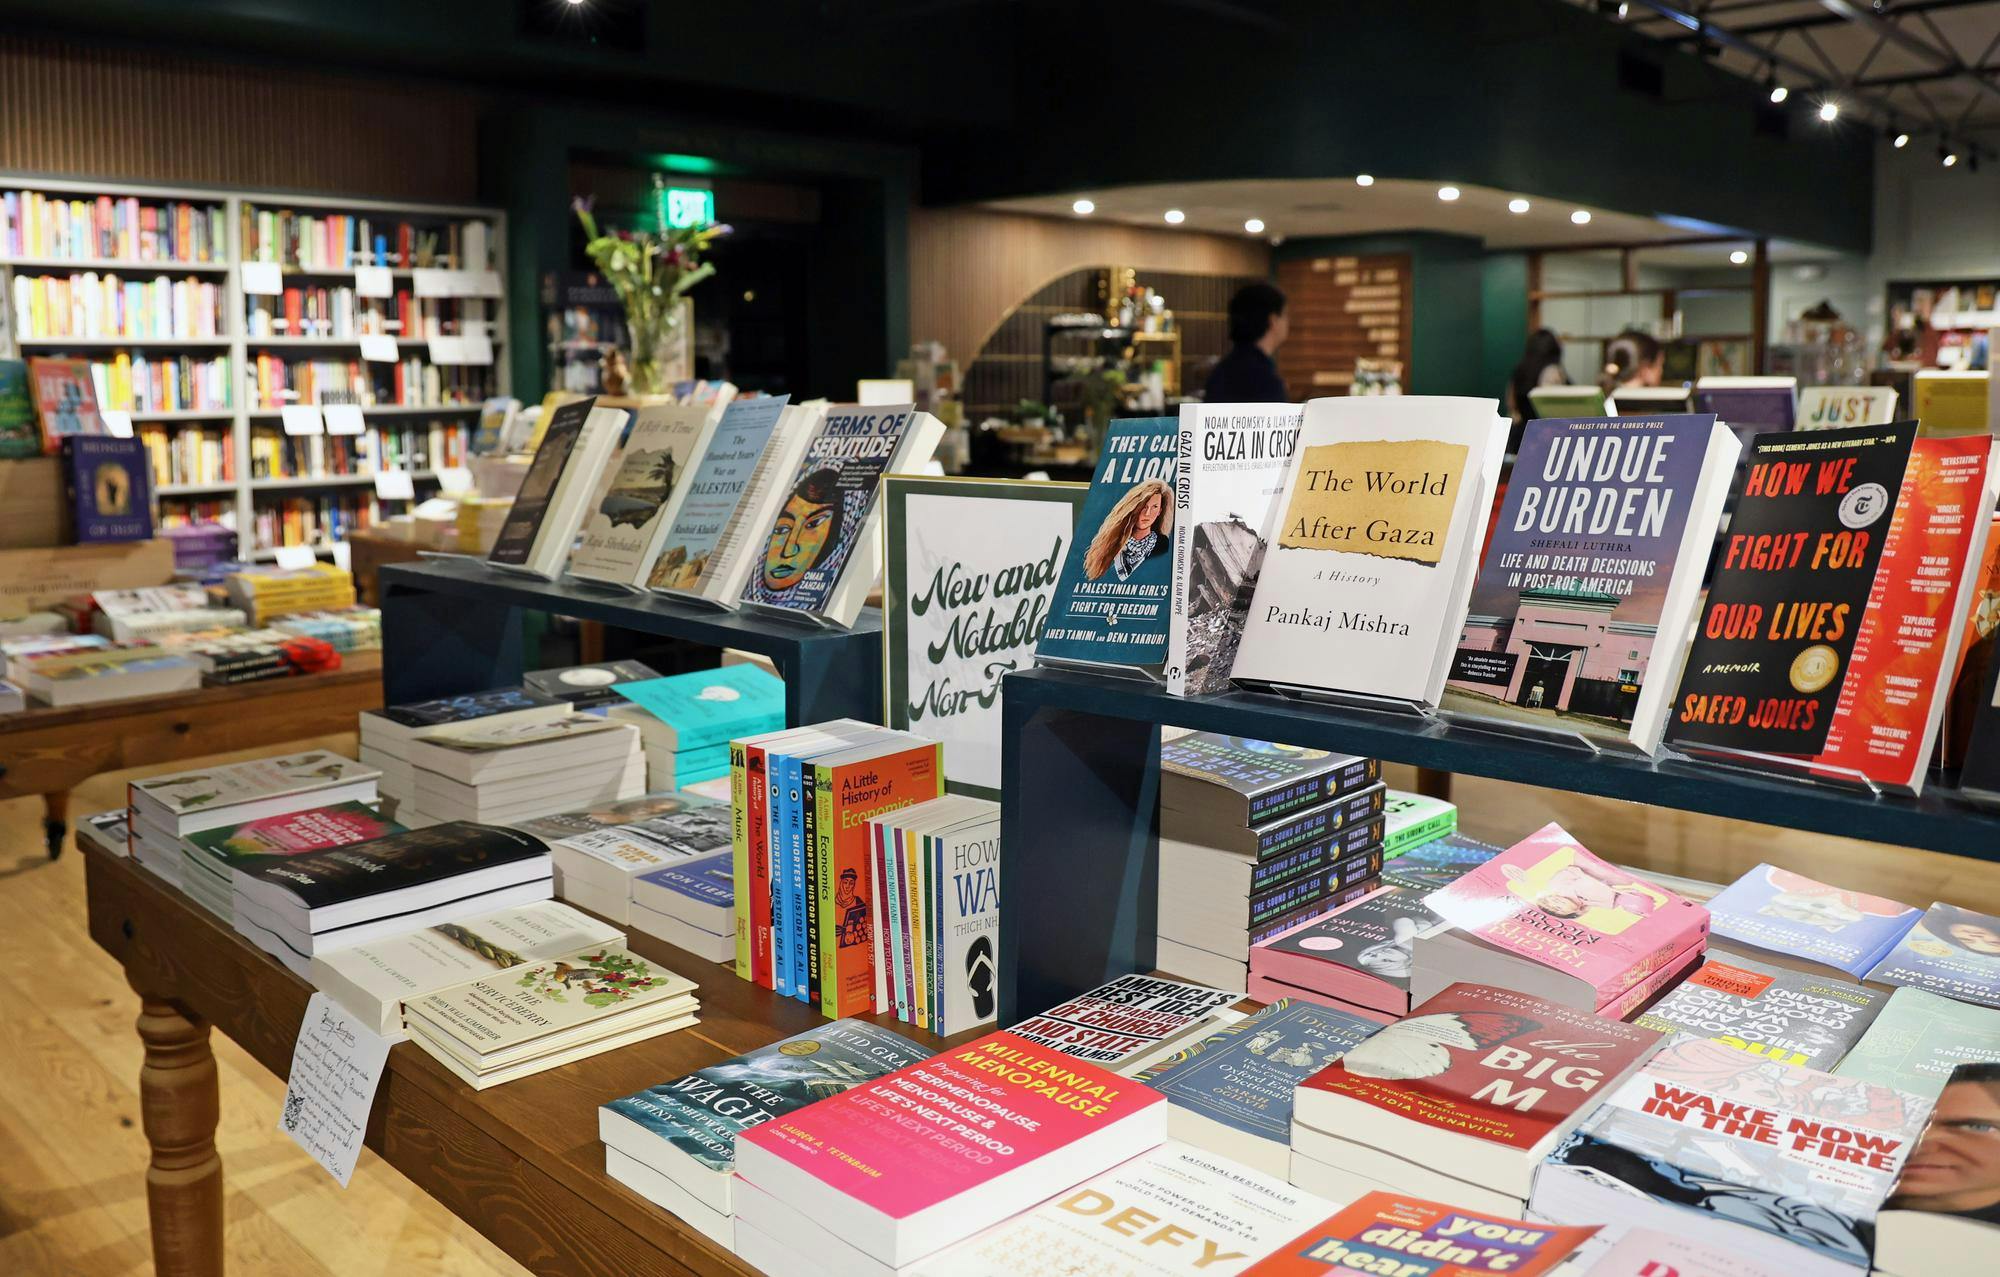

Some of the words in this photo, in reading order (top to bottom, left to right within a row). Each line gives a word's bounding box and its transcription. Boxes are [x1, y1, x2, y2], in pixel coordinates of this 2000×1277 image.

[1204, 416, 1229, 430] NOAM
[1231, 415, 1265, 429] CHOMSKY
[1266, 417, 1271, 428] &
[1811, 396, 1875, 422] JUST
[822, 415, 873, 435] TERMS
[878, 414, 906, 434] OF
[1646, 421, 1665, 429] PRIZE
[733, 435, 747, 445] The
[809, 436, 896, 458] SERVITUDE
[1110, 435, 1147, 453] THEY
[1150, 434, 1180, 452] CAL
[1179, 430, 1193, 459] GAZA
[1203, 431, 1246, 461] GAZA
[1251, 431, 1265, 459] IN
[1101, 464, 1114, 484] A
[1117, 457, 1178, 484] LION
[1179, 461, 1191, 474] IN
[1543, 435, 1675, 483] UNDUE
[689, 480, 745, 495] PALESTINE
[1178, 476, 1191, 510] CRISIS
[1306, 469, 1353, 492] The
[1366, 470, 1448, 496] World
[1746, 461, 1813, 498] HOW
[1816, 458, 1857, 495] WE
[1514, 486, 1673, 538] BURDEN
[1288, 516, 1356, 541] After
[1366, 519, 1435, 546] Gaza
[1530, 539, 1579, 551] SHEFALI
[1583, 541, 1632, 553] LUTHRA
[1500, 553, 1524, 568] LIFE
[1525, 555, 1549, 570] AND
[1552, 556, 1589, 572] DEATH
[1591, 558, 1656, 577] DECISIONS
[1724, 532, 1809, 571] FIGHT
[1811, 530, 1870, 570] FOR
[799, 581, 826, 591] ZAHZAH
[804, 572, 825, 582] OMAR
[911, 562, 990, 616] New
[993, 535, 1062, 598] and
[1074, 583, 1080, 593] A
[1080, 583, 1137, 596] PALESTINIAN
[1138, 584, 1169, 597] GIRL'S
[1313, 570, 1321, 580] A
[1328, 571, 1381, 587] History
[1507, 572, 1521, 587] IN
[1523, 574, 1577, 592] POST-ROE
[1579, 577, 1634, 596] AMERICA
[1070, 601, 1097, 613] FIGHT
[1098, 602, 1115, 616] FOR
[1117, 603, 1159, 616] FREEDOM
[1264, 605, 1331, 632] Pankaj
[1338, 612, 1410, 636] Mishra
[1706, 603, 1762, 640] OUR
[1767, 602, 1849, 641] LIVES
[1044, 628, 1065, 640] AHED
[1066, 629, 1095, 642] TAMIMI
[1107, 631, 1128, 643] DENA
[1129, 632, 1166, 645] TAKRURI
[1702, 663, 1712, 674] A
[1713, 662, 1760, 675] MEMOIR
[1680, 693, 1747, 725] SAEED
[1748, 698, 1819, 731] JONES
[842, 775, 852, 792] A
[853, 771, 879, 790] Little
[1343, 773, 1364, 788] BARNETT
[1344, 763, 1364, 777] CYNTHIA
[841, 786, 880, 807] History
[880, 781, 893, 797] of
[1252, 800, 1264, 811] THE
[1265, 793, 1285, 807] SOUND
[1286, 789, 1294, 800] OF
[1296, 785, 1306, 796] THE
[1308, 780, 1319, 792] SEA
[735, 807, 743, 842] Music
[754, 815, 763, 840] The
[806, 811, 814, 829] THE
[755, 842, 765, 879] World
[807, 833, 815, 882] SHORTEST
[820, 835, 831, 901] Economics
[886, 858, 894, 880] THICH
[954, 838, 1000, 870] HOW
[663, 871, 695, 884] RON
[888, 881, 896, 902] NHAT
[808, 885, 816, 925] HISTORY
[889, 903, 898, 924] HANH
[810, 928, 817, 940] OF
[1316, 924, 1386, 942] BRITNEY
[1330, 918, 1389, 932] SPEARS
[810, 943, 818, 979] EUROPE
[937, 962, 944, 973] TO
[1113, 976, 1239, 1006] AMERICA'S
[1893, 967, 1991, 992] UNKNOWN
[471, 982, 552, 1026] SERVICEBERRY
[516, 991, 542, 1006] THE
[1077, 997, 1109, 1012] THE
[1109, 1002, 1197, 1027] SEPARATION
[1087, 987, 1145, 1007] BEST
[1155, 1000, 1214, 1021] IDEA
[1494, 991, 1550, 1010] WRITERS
[1556, 1008, 1588, 1021] TAKE
[1595, 1021, 1632, 1033] BACK
[1670, 990, 1790, 1026] WARHOL
[1769, 988, 1863, 1013] AGAIN)
[1048, 1004, 1087, 1021] OF
[1082, 1009, 1177, 1038] CHURCH
[1456, 990, 1480, 998] THE
[1484, 996, 1527, 1009] STORY
[1532, 1008, 1550, 1016] OF
[1555, 1015, 1640, 1042] MENOPAUSE
[819, 1025, 870, 1049] DAVID
[870, 1043, 910, 1069] GRA
[1017, 1019, 1069, 1041] AND
[1066, 1027, 1149, 1054] STATE
[1644, 1006, 1822, 1058] PHILOSOPHY
[1529, 1039, 1616, 1061] the
[929, 1061, 984, 1096] Preparing
[984, 1079, 1008, 1098] for
[979, 1041, 1120, 1103] MILLENNIAL
[1219, 1063, 1264, 1083] Oxford
[1479, 1045, 1605, 1092] BIG
[740, 1081, 785, 1107] THE
[955, 1050, 1110, 1119] MENOPAUSE
[1212, 1087, 1269, 1111] OGILVIE
[1223, 1074, 1292, 1104] Dictionary
[1224, 1084, 1269, 1102] SARAH
[1470, 1078, 1549, 1112] M
[671, 1075, 777, 1130] WAGE
[890, 1077, 984, 1128] MENOPAUSE
[981, 1118, 996, 1131] &
[910, 1069, 1042, 1132] PERIMENOPAUSE,
[869, 1085, 912, 1113] LIFE'S
[908, 1099, 958, 1134] NEXT
[951, 1120, 1015, 1157] PERIOD
[1374, 1095, 1412, 1112] LIDIA
[1418, 1108, 1516, 1139] YUKNAVITCH
[1653, 1082, 1779, 1128] WAKE
[1786, 1119, 1903, 1154] NOW
[1641, 1096, 1689, 1123] IN
[1700, 1106, 1784, 1145] THE
[1792, 1136, 1898, 1173] FIRE
[1180, 1154, 1230, 1177] NATIONAL
[1232, 1174, 1297, 1206] BESTSELLER
[1055, 1188, 1252, 1269] DEFY
[1436, 1216, 1545, 1246] you
[1307, 1240, 1430, 1277] hear
[1360, 1226, 1520, 1270] didn't
